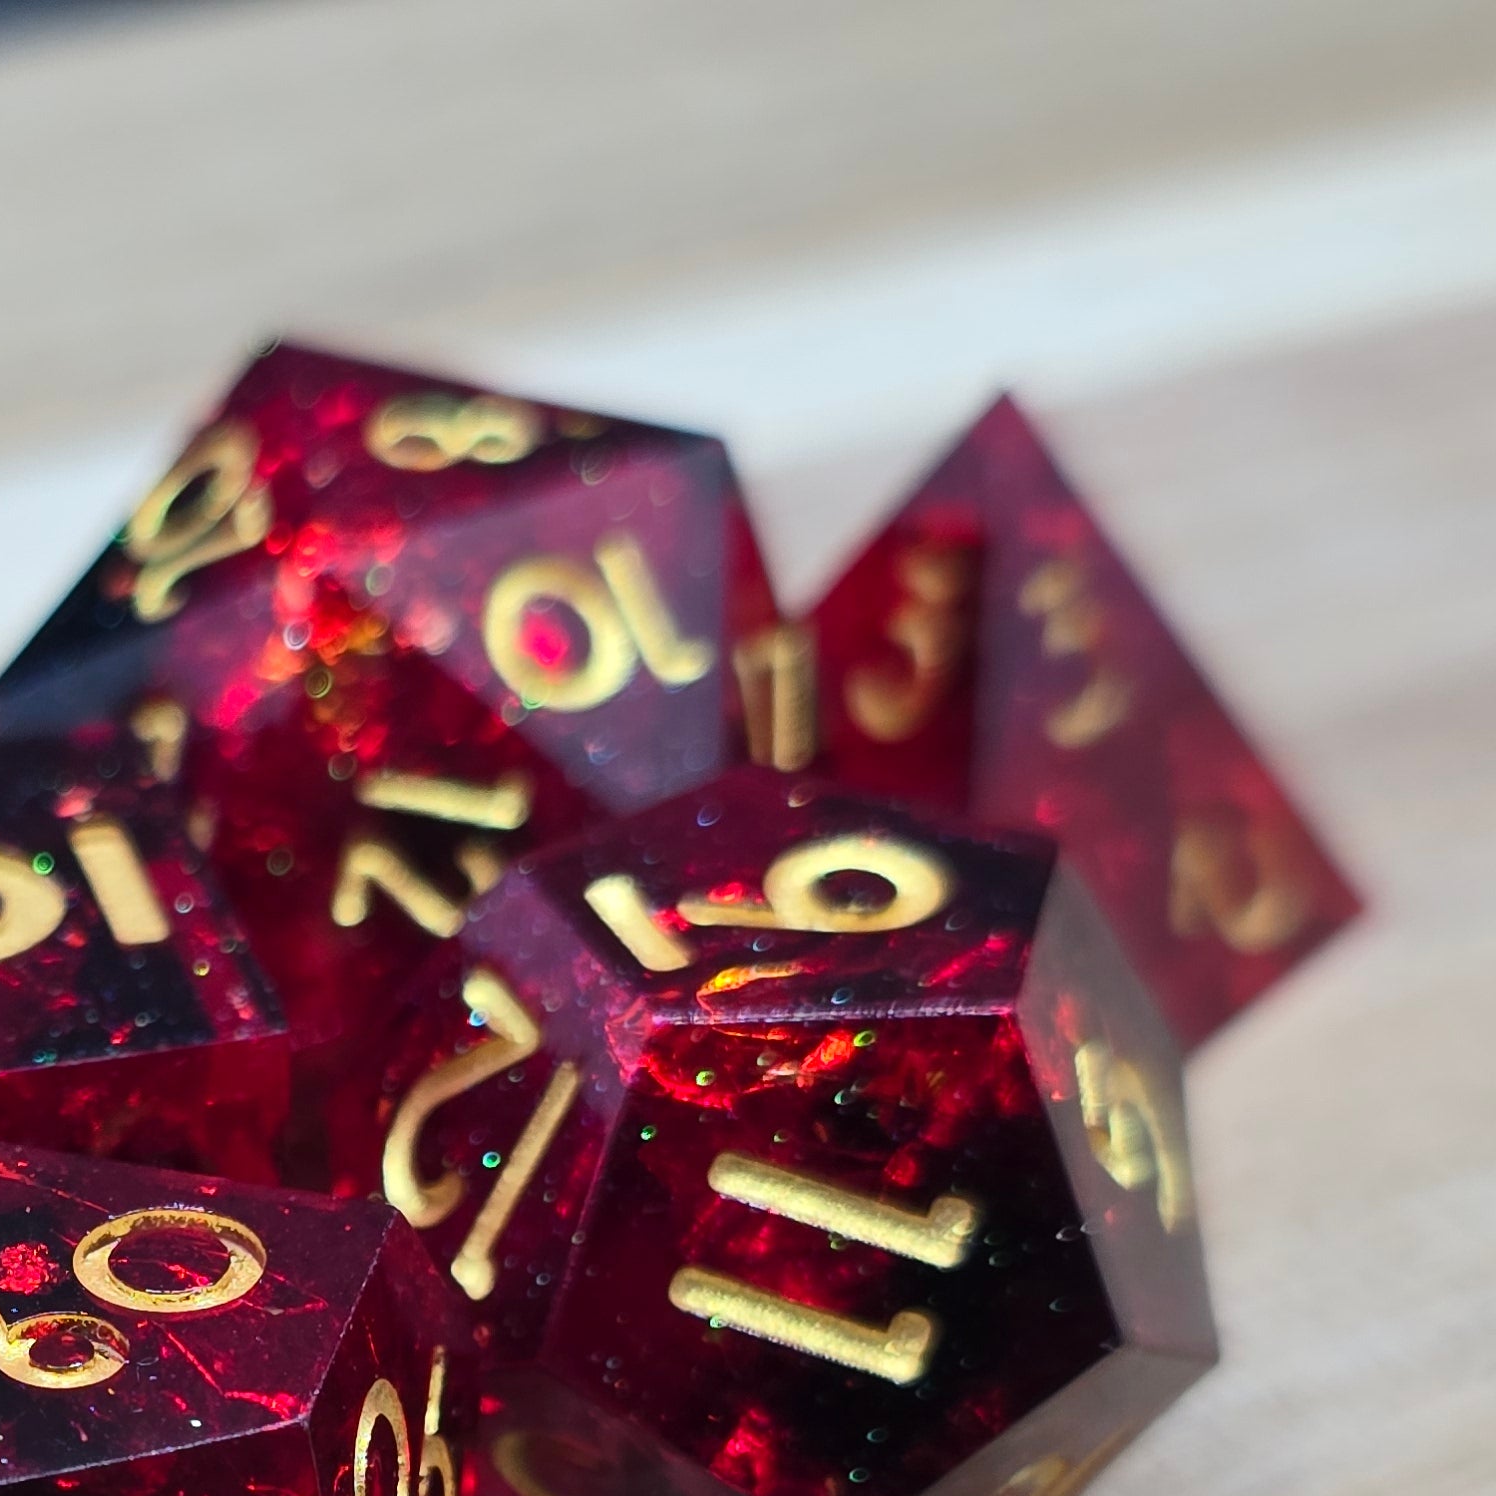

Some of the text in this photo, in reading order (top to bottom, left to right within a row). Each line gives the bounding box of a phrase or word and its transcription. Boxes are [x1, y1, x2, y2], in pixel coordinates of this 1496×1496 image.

[363, 392, 542, 472] 8
[484, 534, 712, 711] 10
[667, 1151, 980, 1387] 11
